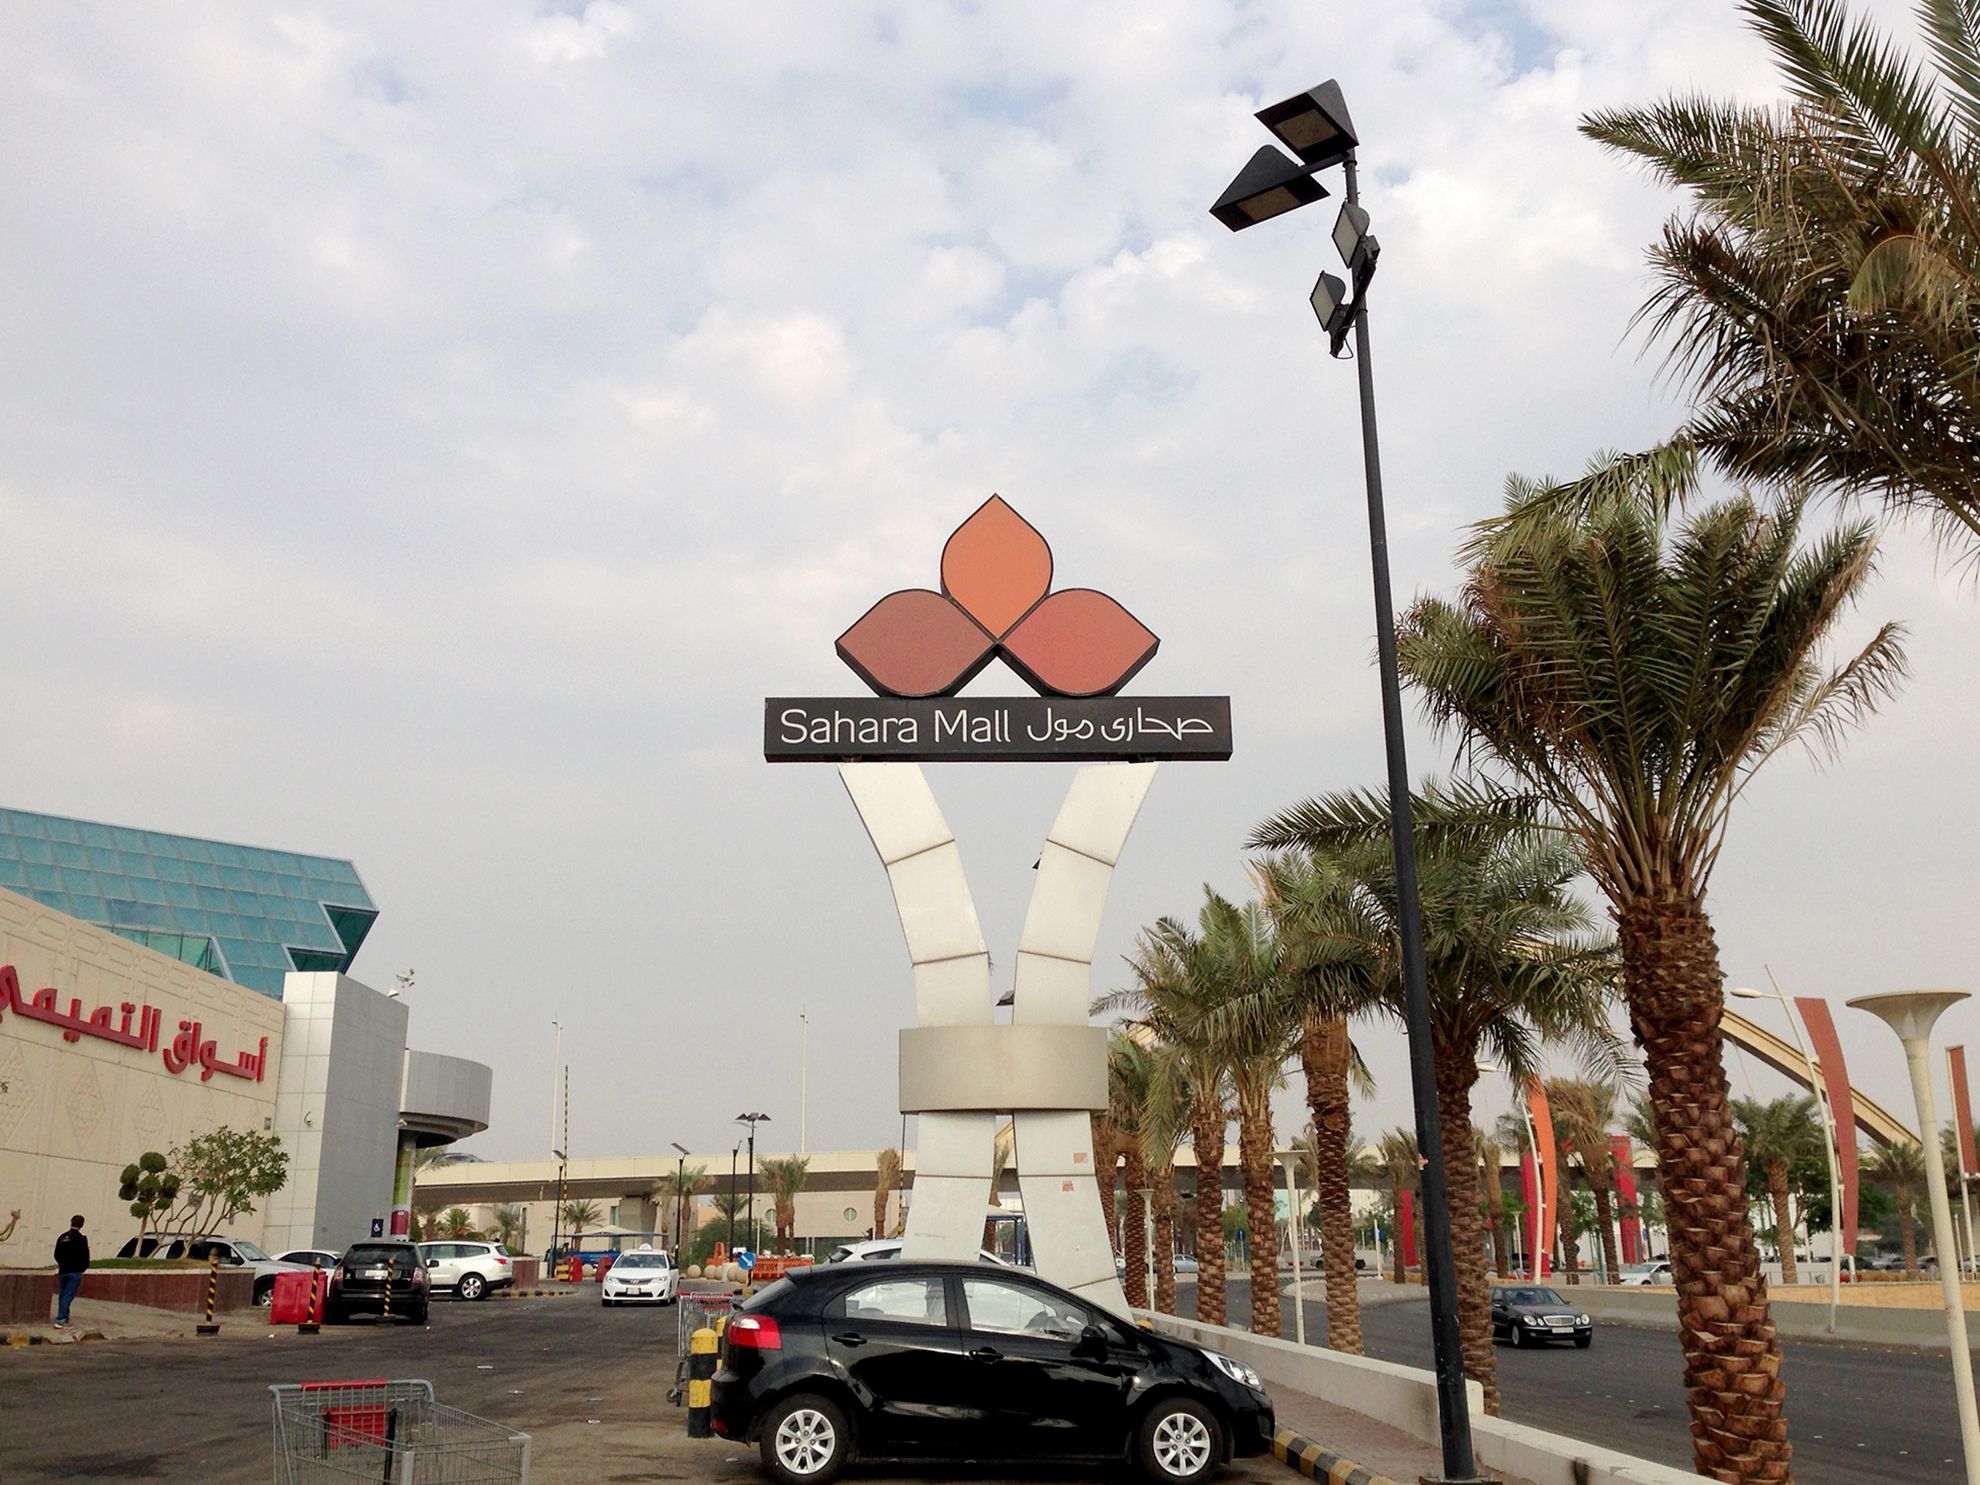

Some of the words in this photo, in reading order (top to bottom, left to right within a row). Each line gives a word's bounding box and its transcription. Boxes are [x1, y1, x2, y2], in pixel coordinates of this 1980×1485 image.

[780, 708, 918, 744] Sahara
[934, 709, 1010, 743] Mall
[1027, 707, 1094, 743] مول
[163, 1021, 269, 1082] أسواق
